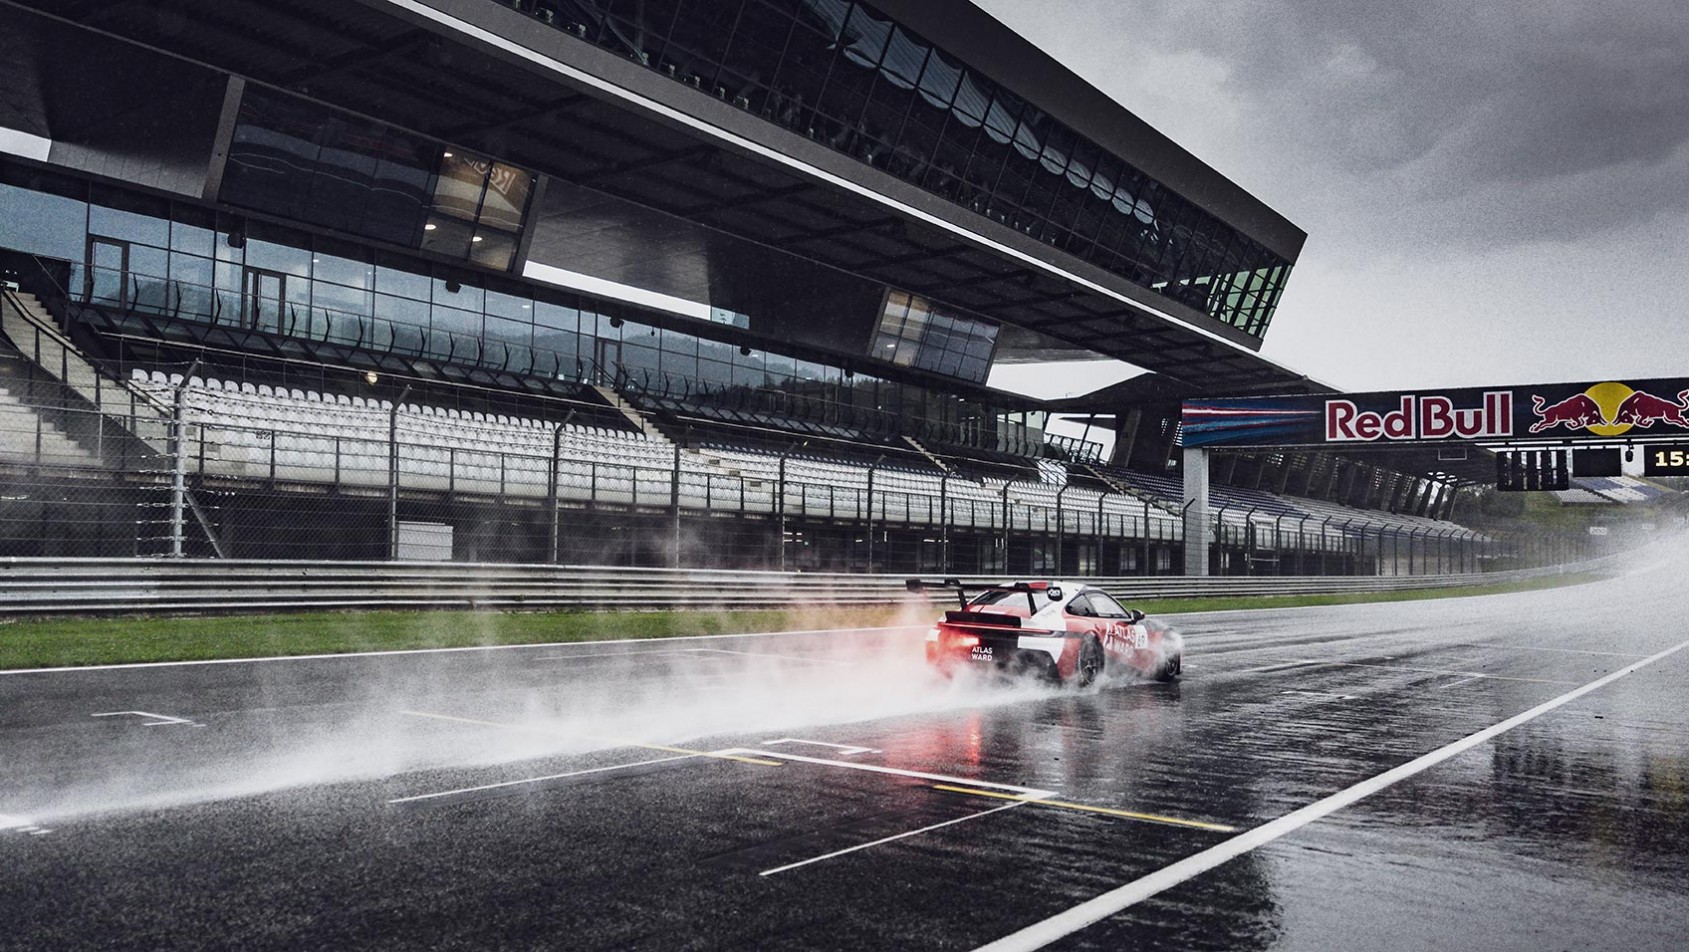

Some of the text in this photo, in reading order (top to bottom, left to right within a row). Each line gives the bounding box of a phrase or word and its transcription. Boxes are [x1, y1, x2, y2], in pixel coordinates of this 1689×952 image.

[1326, 389, 1513, 441] Red Bull
[1115, 623, 1135, 644] ATLAS
[971, 646, 993, 654] ATLAS
[971, 653, 993, 661] WARD
[1114, 639, 1134, 658] WARD
